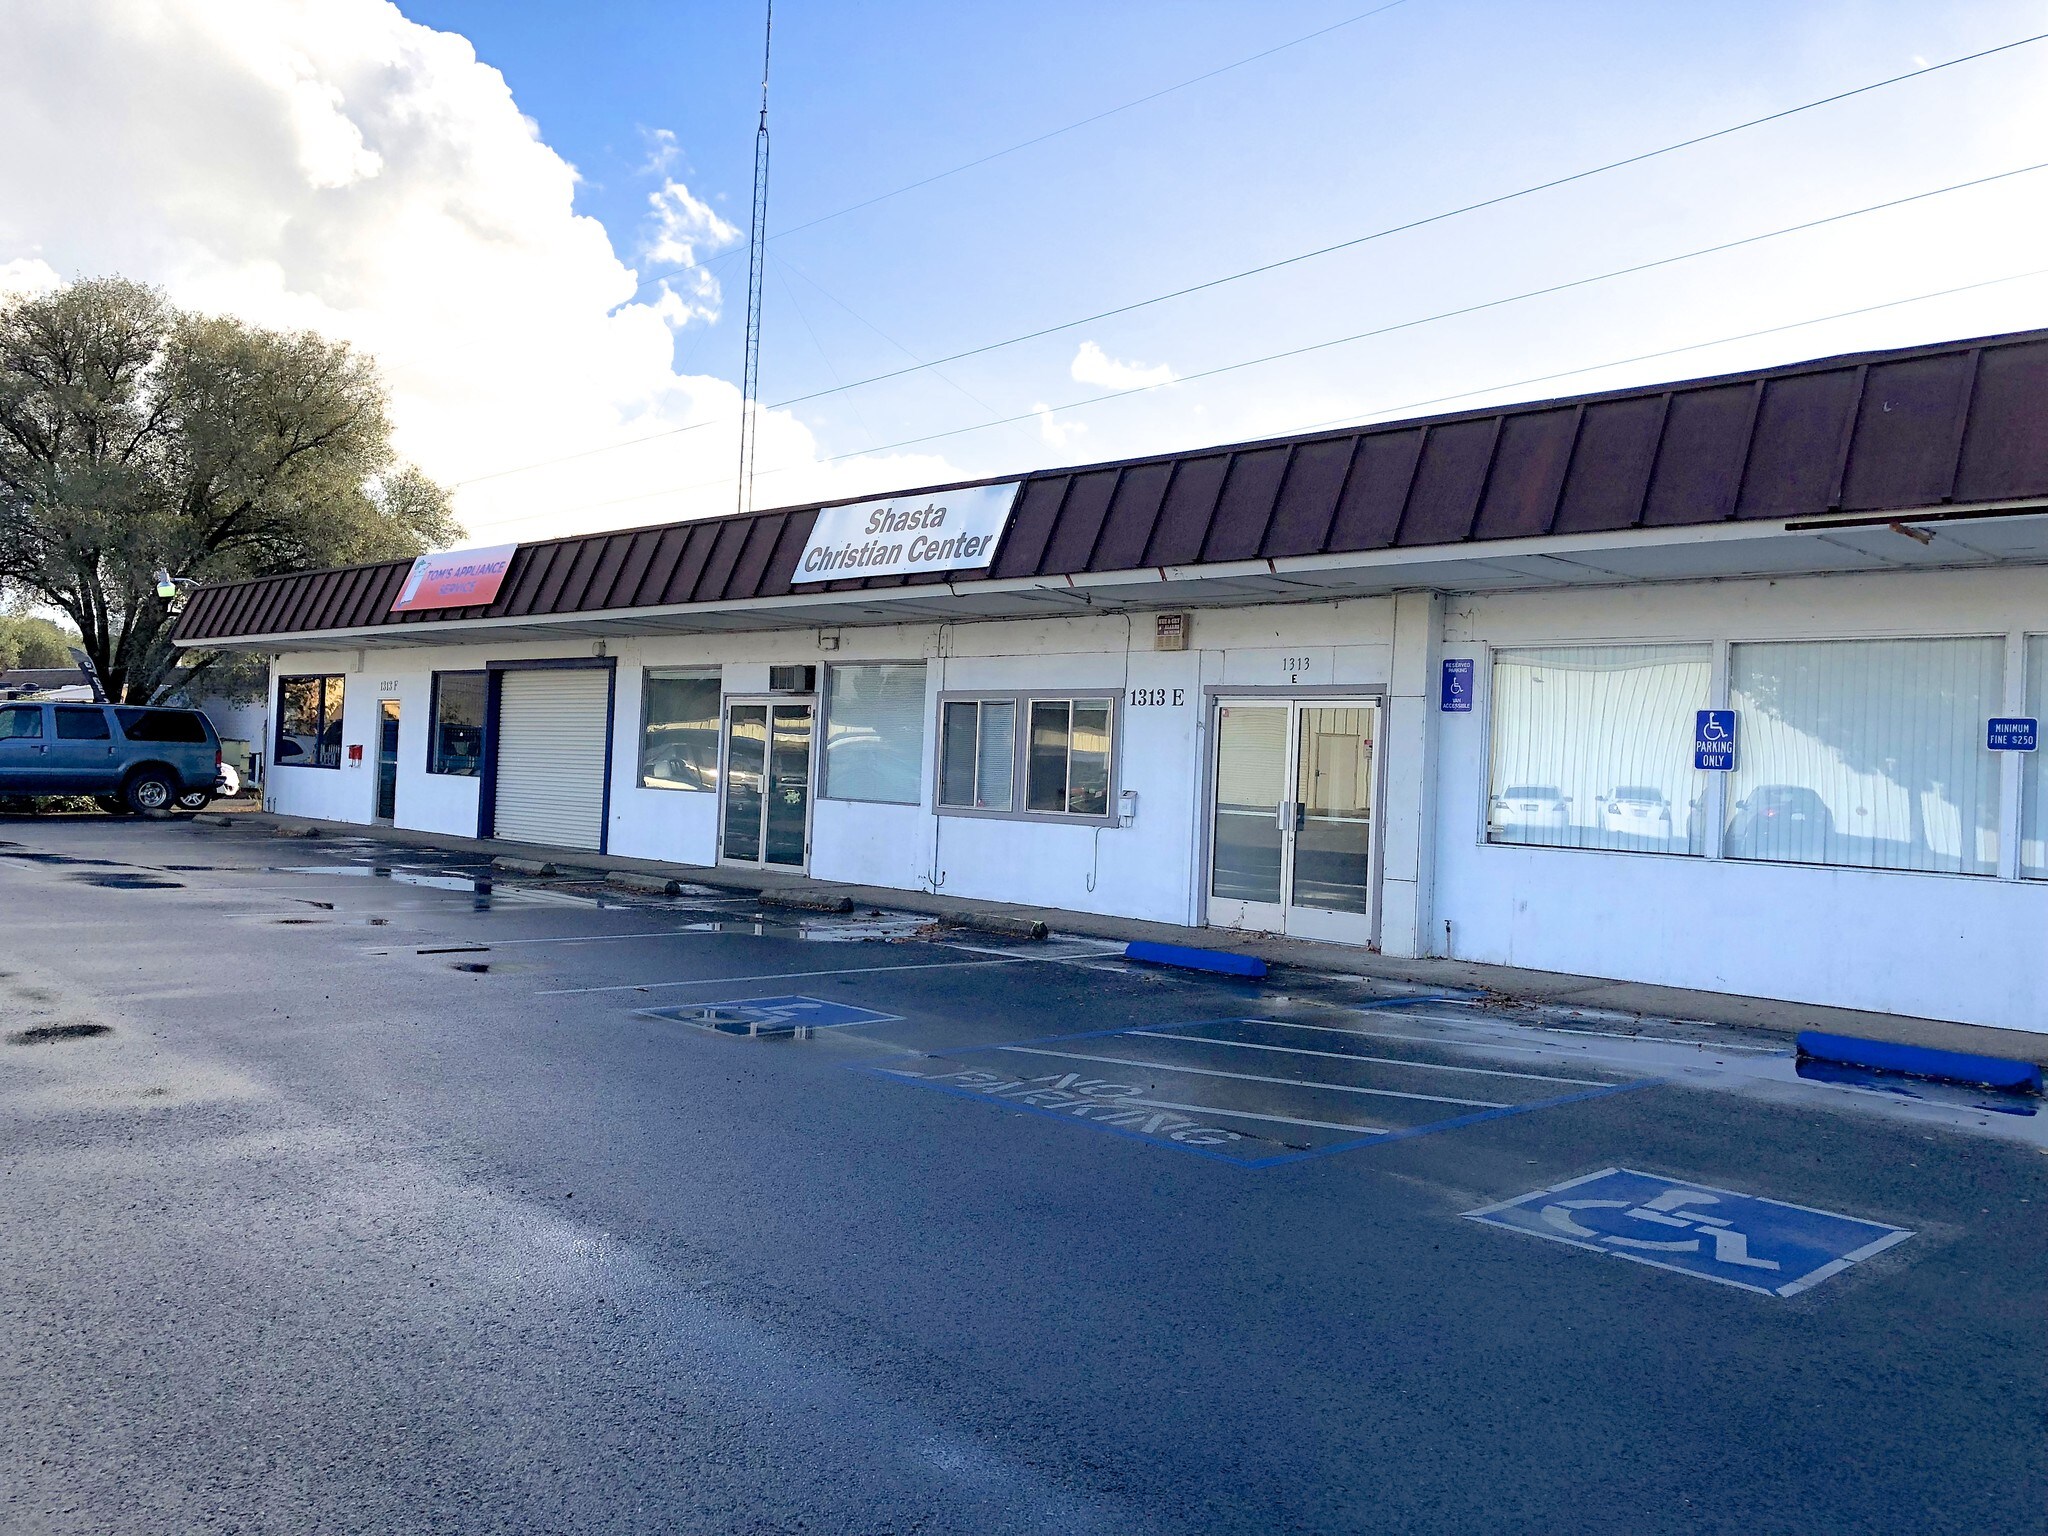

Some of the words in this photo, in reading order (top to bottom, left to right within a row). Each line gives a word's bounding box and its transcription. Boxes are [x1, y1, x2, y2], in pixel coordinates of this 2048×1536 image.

[865, 503, 947, 534] Shasta
[804, 540, 903, 572] Christian
[907, 532, 993, 563] Center
[427, 567, 452, 580] TOM'S
[453, 561, 506, 577] APPLIANCE
[1282, 657, 1310, 671] 1313
[380, 681, 393, 692] 1313
[393, 680, 399, 691] F
[1291, 674, 1298, 684] E
[1130, 689, 1166, 706] 1313
[1172, 689, 1185, 706] E
[1995, 723, 2030, 733] MINIMUM
[1696, 740, 1733, 754] PARKING
[1990, 735, 2008, 744] FINE
[2011, 735, 2034, 745] $250
[1702, 754, 1725, 767] ONLY
[954, 1071, 1242, 1146] PARKING
